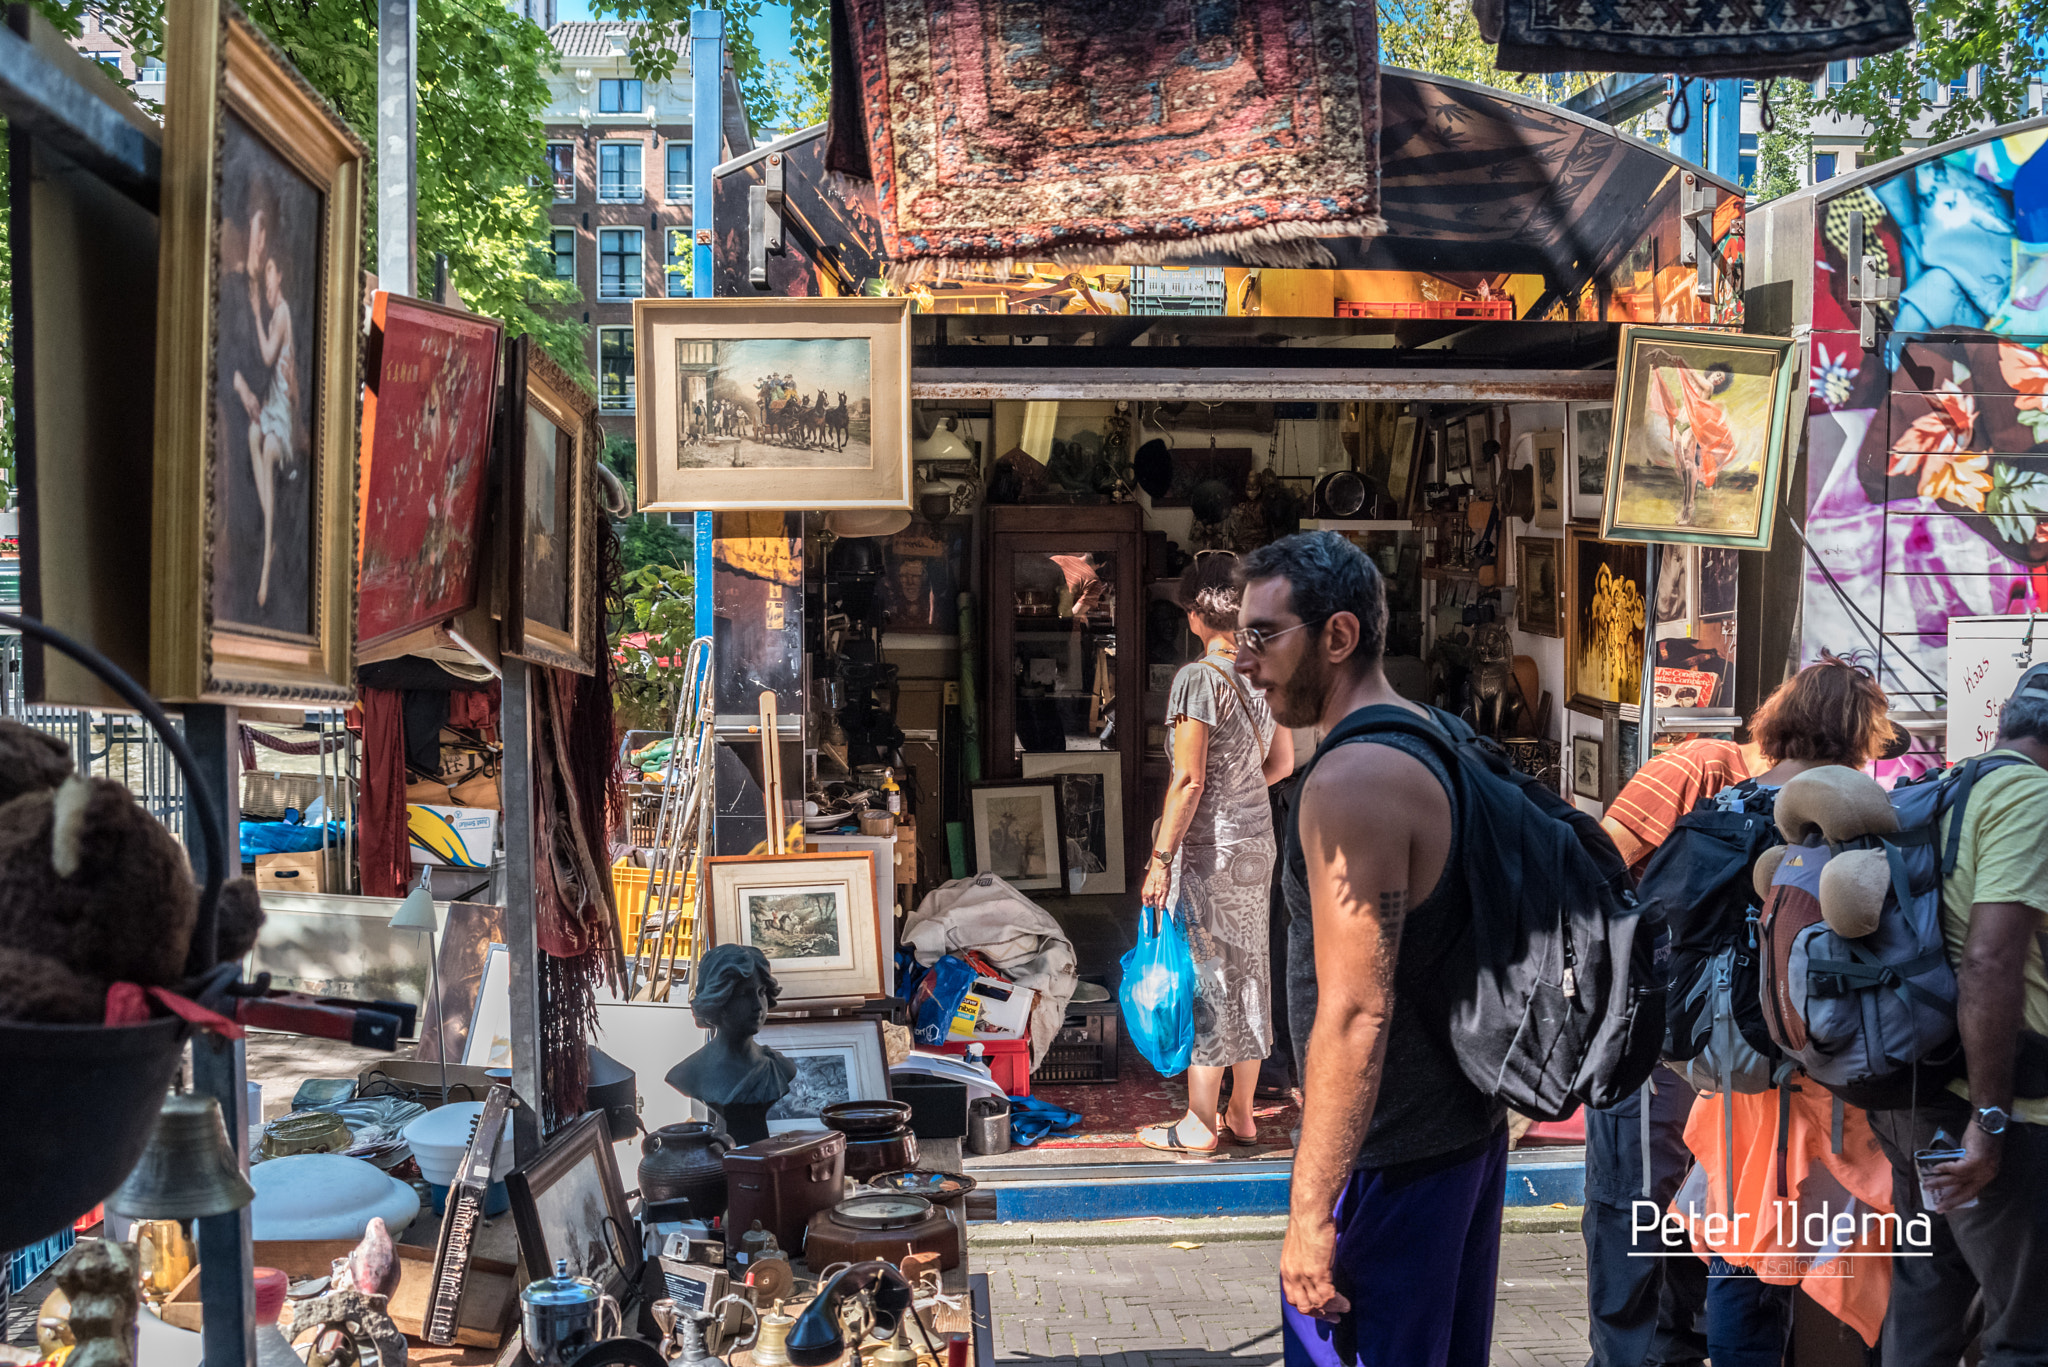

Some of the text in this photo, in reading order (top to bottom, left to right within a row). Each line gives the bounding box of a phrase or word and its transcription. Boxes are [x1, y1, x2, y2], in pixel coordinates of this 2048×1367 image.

[1983, 697, 1998, 718] St
[1976, 725, 1996, 753] Syr
[958, 1004, 977, 1015] nibox
